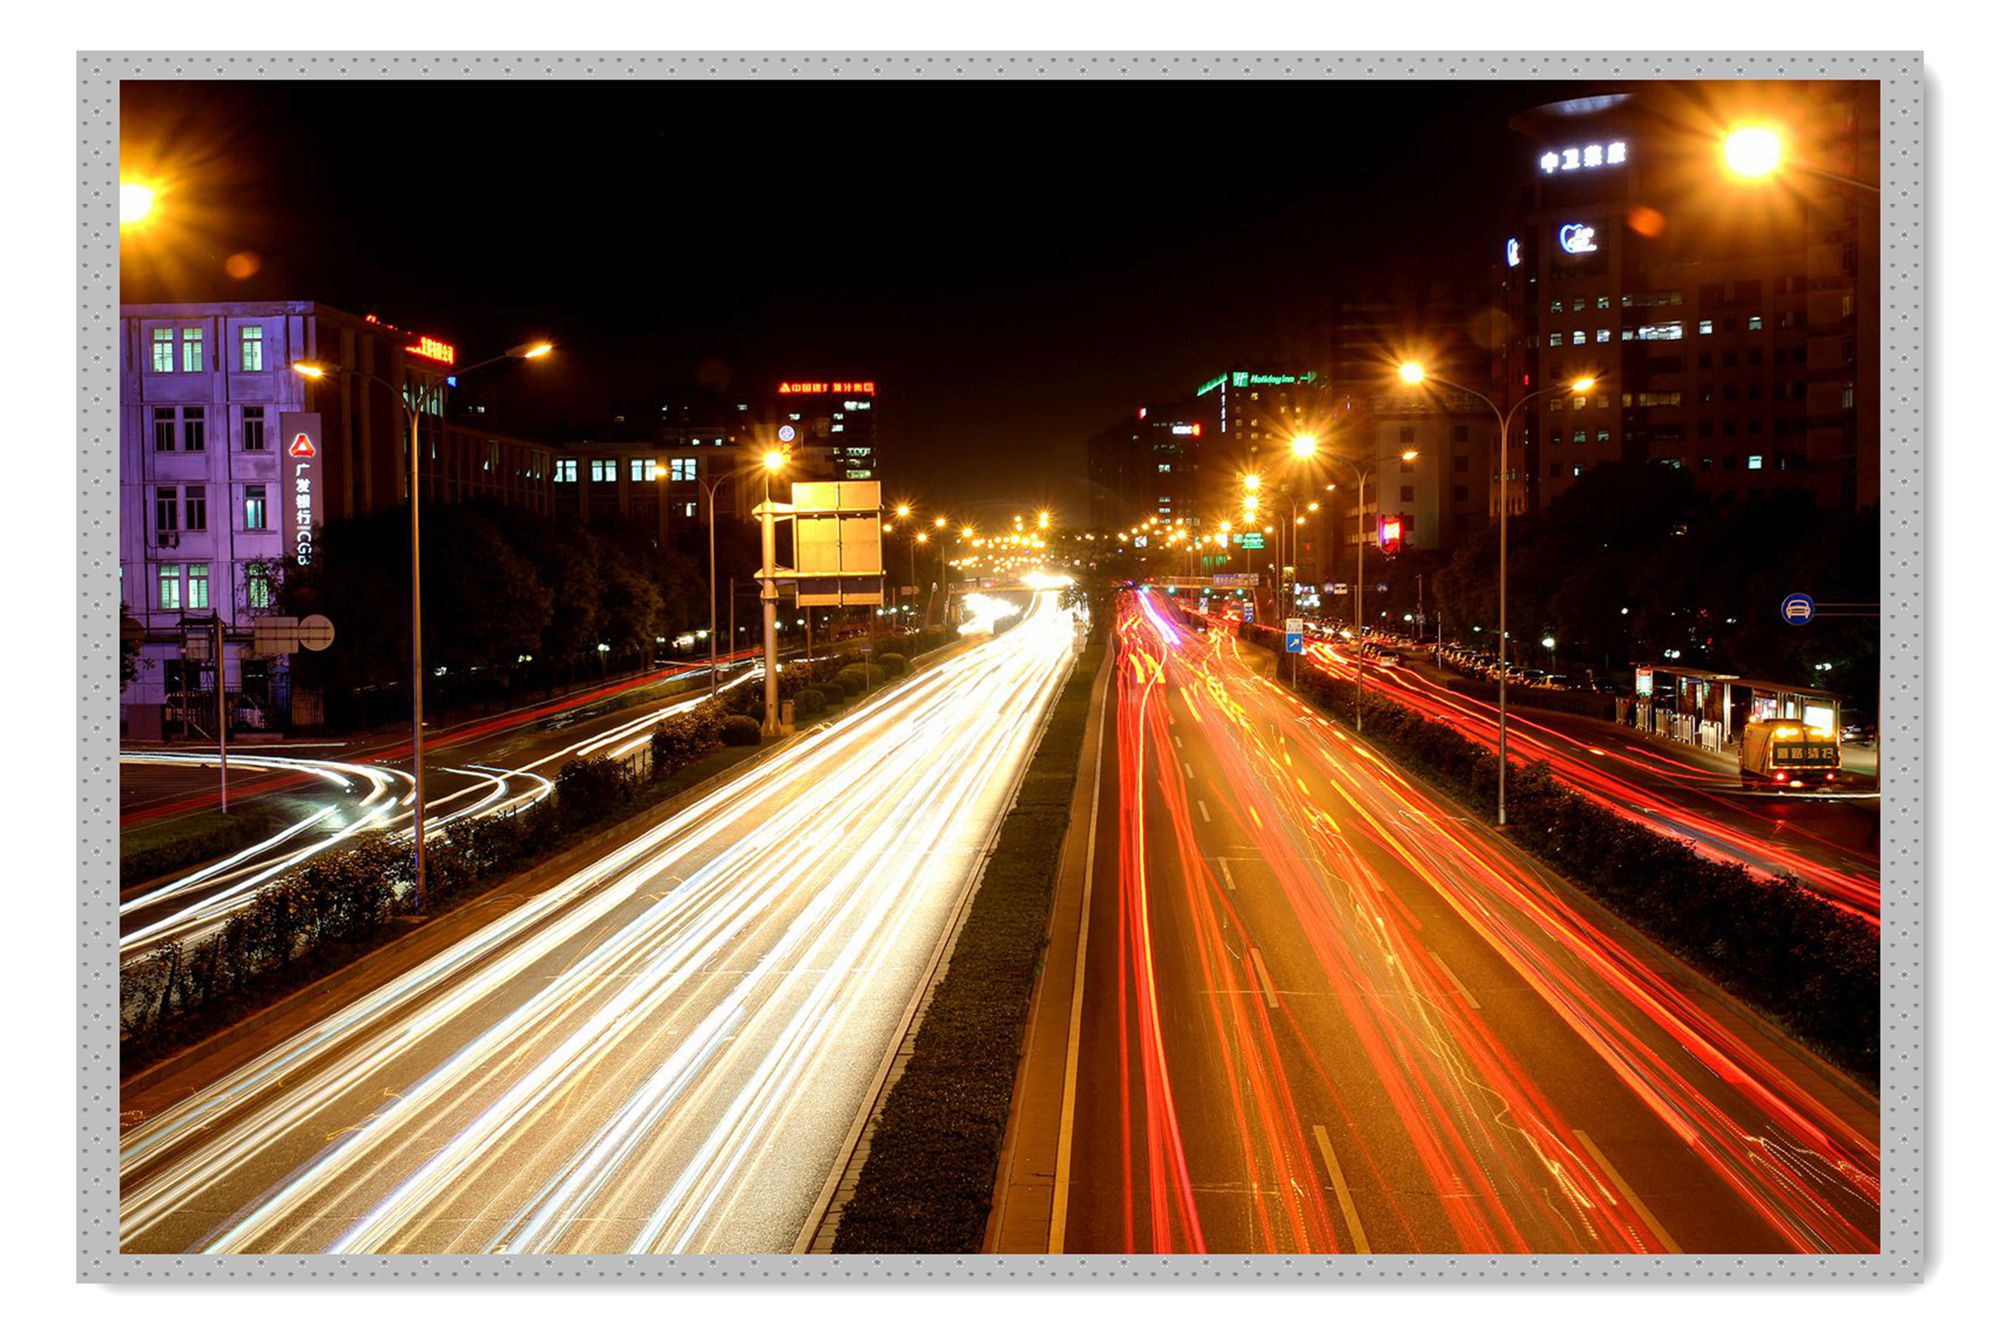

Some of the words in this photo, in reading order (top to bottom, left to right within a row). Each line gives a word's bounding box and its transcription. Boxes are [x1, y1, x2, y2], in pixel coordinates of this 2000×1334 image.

[1250, 374, 1281, 385] Holiday
[296, 463, 311, 525] 广发银行
